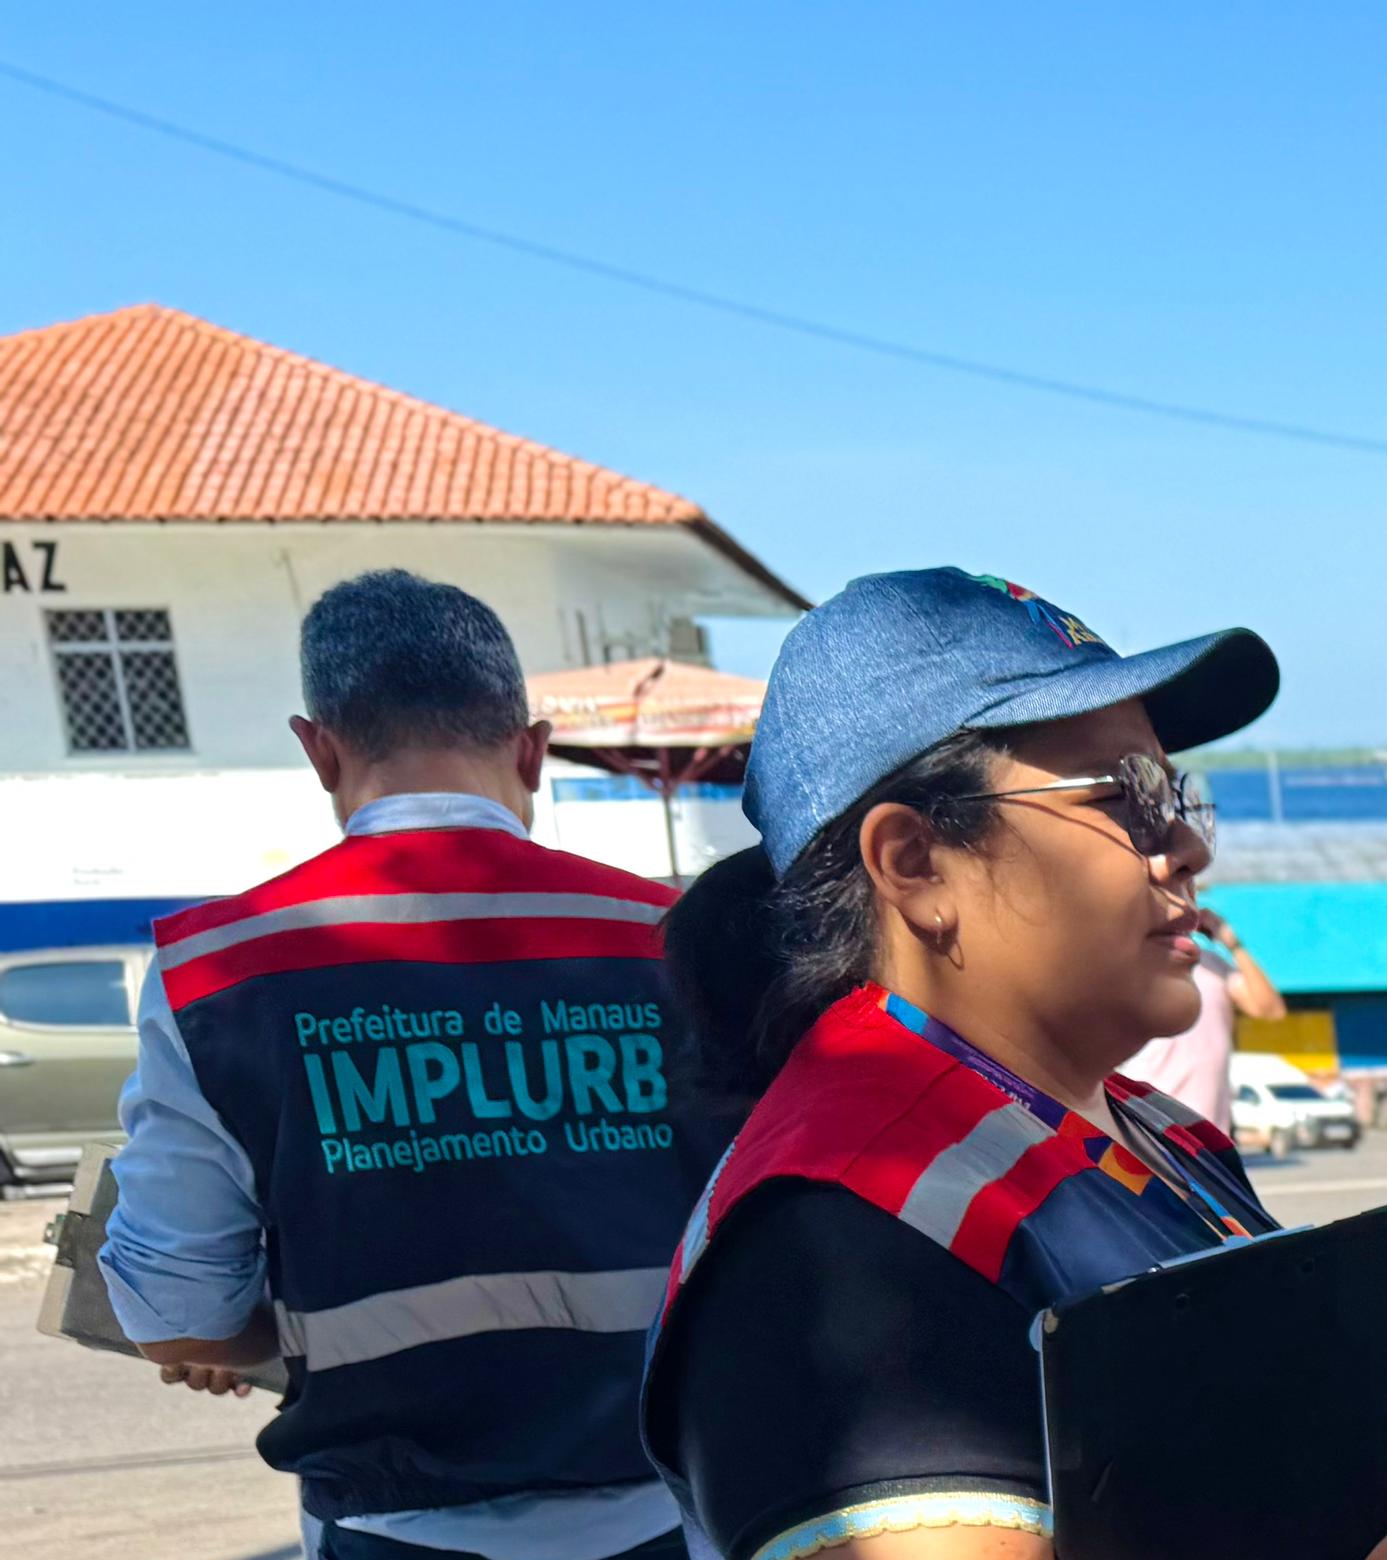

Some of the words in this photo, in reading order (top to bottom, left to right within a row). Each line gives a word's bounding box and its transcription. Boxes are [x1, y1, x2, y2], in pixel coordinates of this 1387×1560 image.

[3, 541, 67, 592] AZ
[295, 1004, 464, 1047] Prefeitura
[484, 1001, 522, 1036] de
[541, 1000, 662, 1034] Manaus
[303, 1032, 668, 1134] IMPLURB
[321, 1124, 547, 1174] Planejamento
[564, 1118, 673, 1152] Urbano
